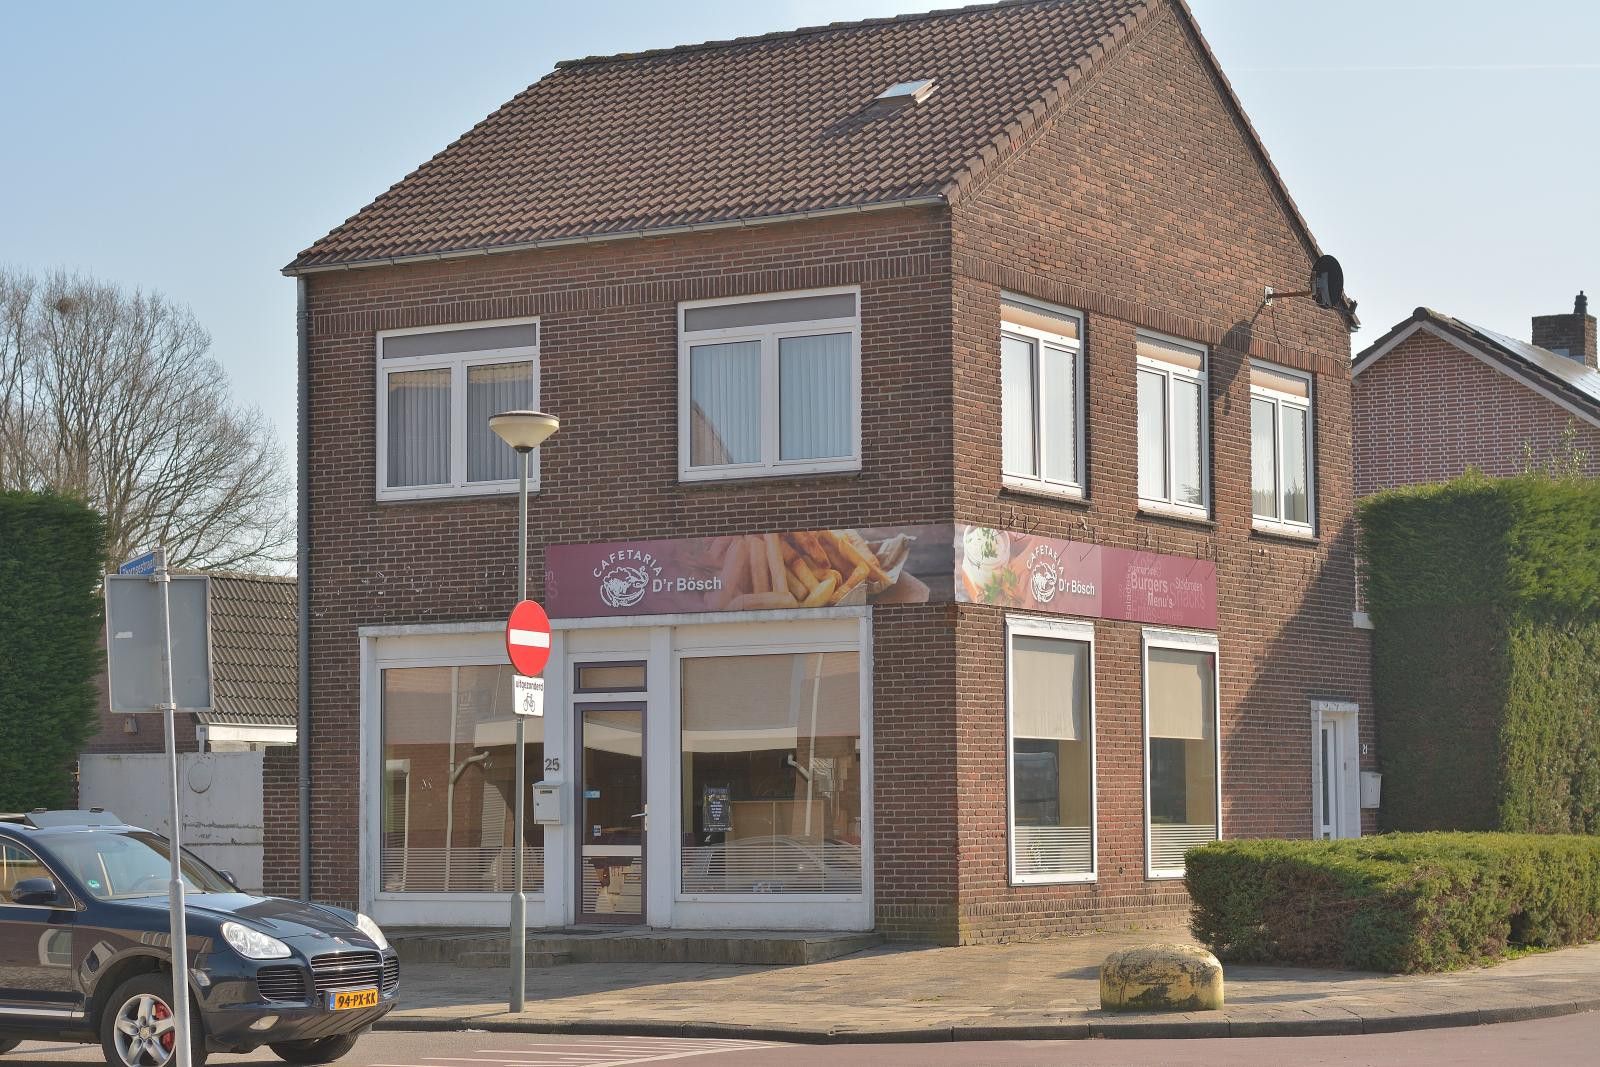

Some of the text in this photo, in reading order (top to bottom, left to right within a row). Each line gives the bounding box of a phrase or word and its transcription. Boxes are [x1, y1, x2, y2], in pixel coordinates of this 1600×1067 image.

[593, 549, 663, 578] CAFETARIA
[1026, 544, 1064, 574] CAFETARIA
[652, 576, 722, 593] D'r Bösch
[1059, 578, 1095, 596] D'r Bösch
[1130, 572, 1168, 593] Burgers
[1147, 590, 1173, 609] Menu's
[515, 680, 543, 691] uitgezonderd
[545, 758, 560, 771] 25
[338, 992, 376, 1008] 94-PX-KK
